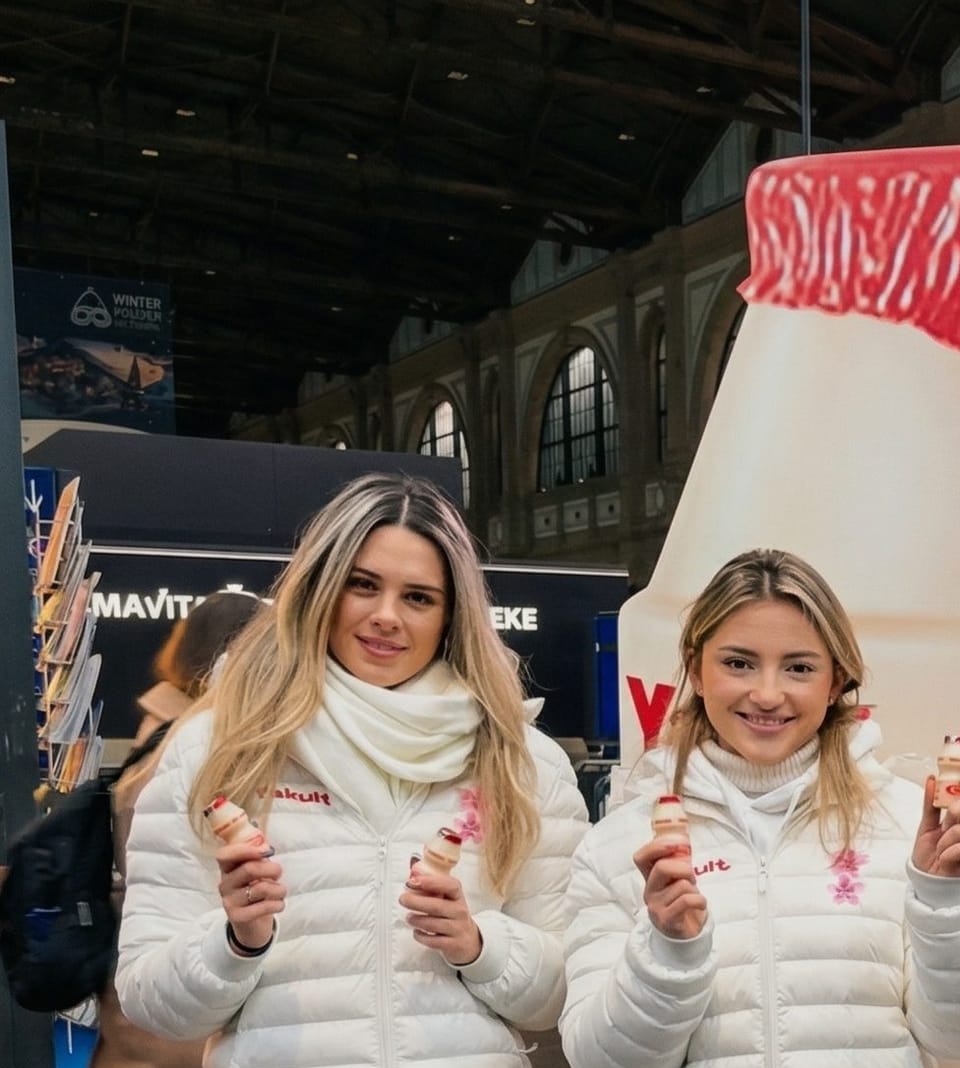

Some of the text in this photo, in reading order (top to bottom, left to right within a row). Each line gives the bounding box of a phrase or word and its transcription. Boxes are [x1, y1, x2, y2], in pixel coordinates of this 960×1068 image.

[112, 293, 162, 310] WINTER
[87, 588, 207, 620] MAVIT
[692, 858, 731, 876] ult
